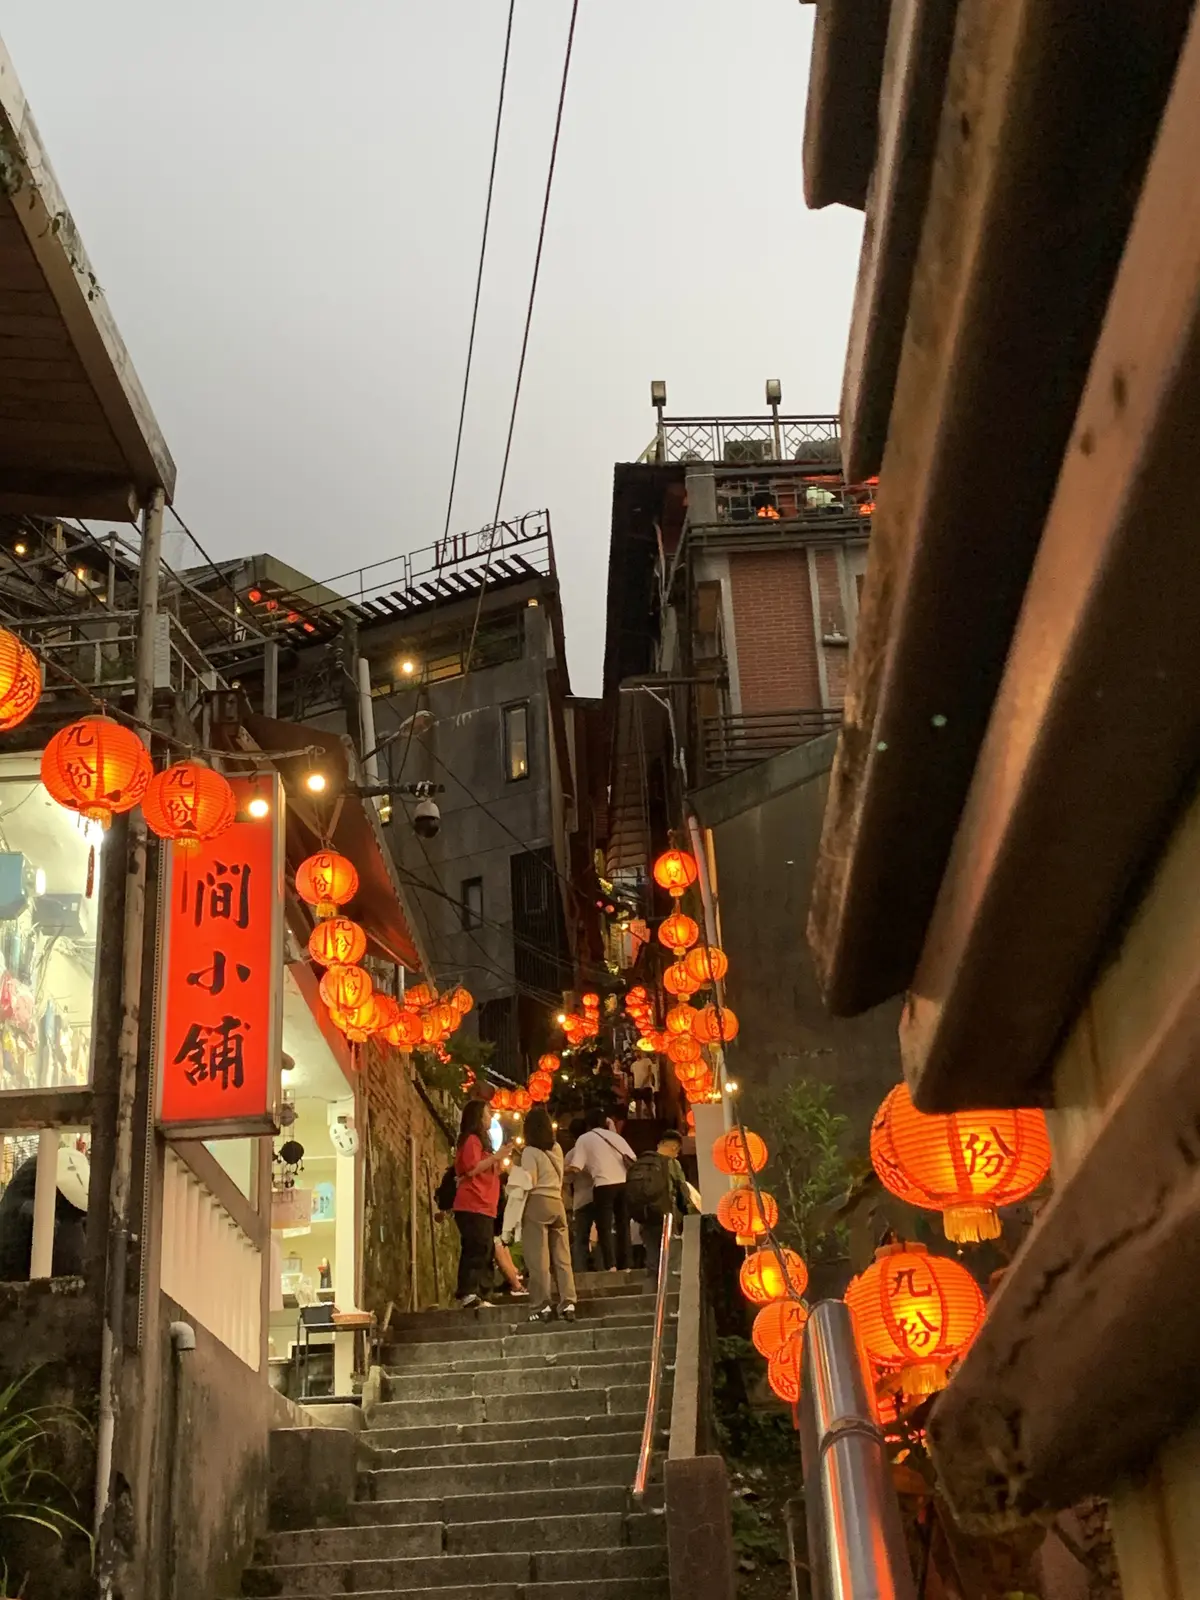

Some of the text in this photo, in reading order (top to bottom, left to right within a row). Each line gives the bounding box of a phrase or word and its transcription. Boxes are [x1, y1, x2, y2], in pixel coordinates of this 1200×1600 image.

[64, 725, 97, 789] 九份
[167, 769, 194, 822] 九份
[312, 856, 331, 892] 九份
[965, 1126, 1017, 1180] 份
[889, 1268, 939, 1349] 九份
